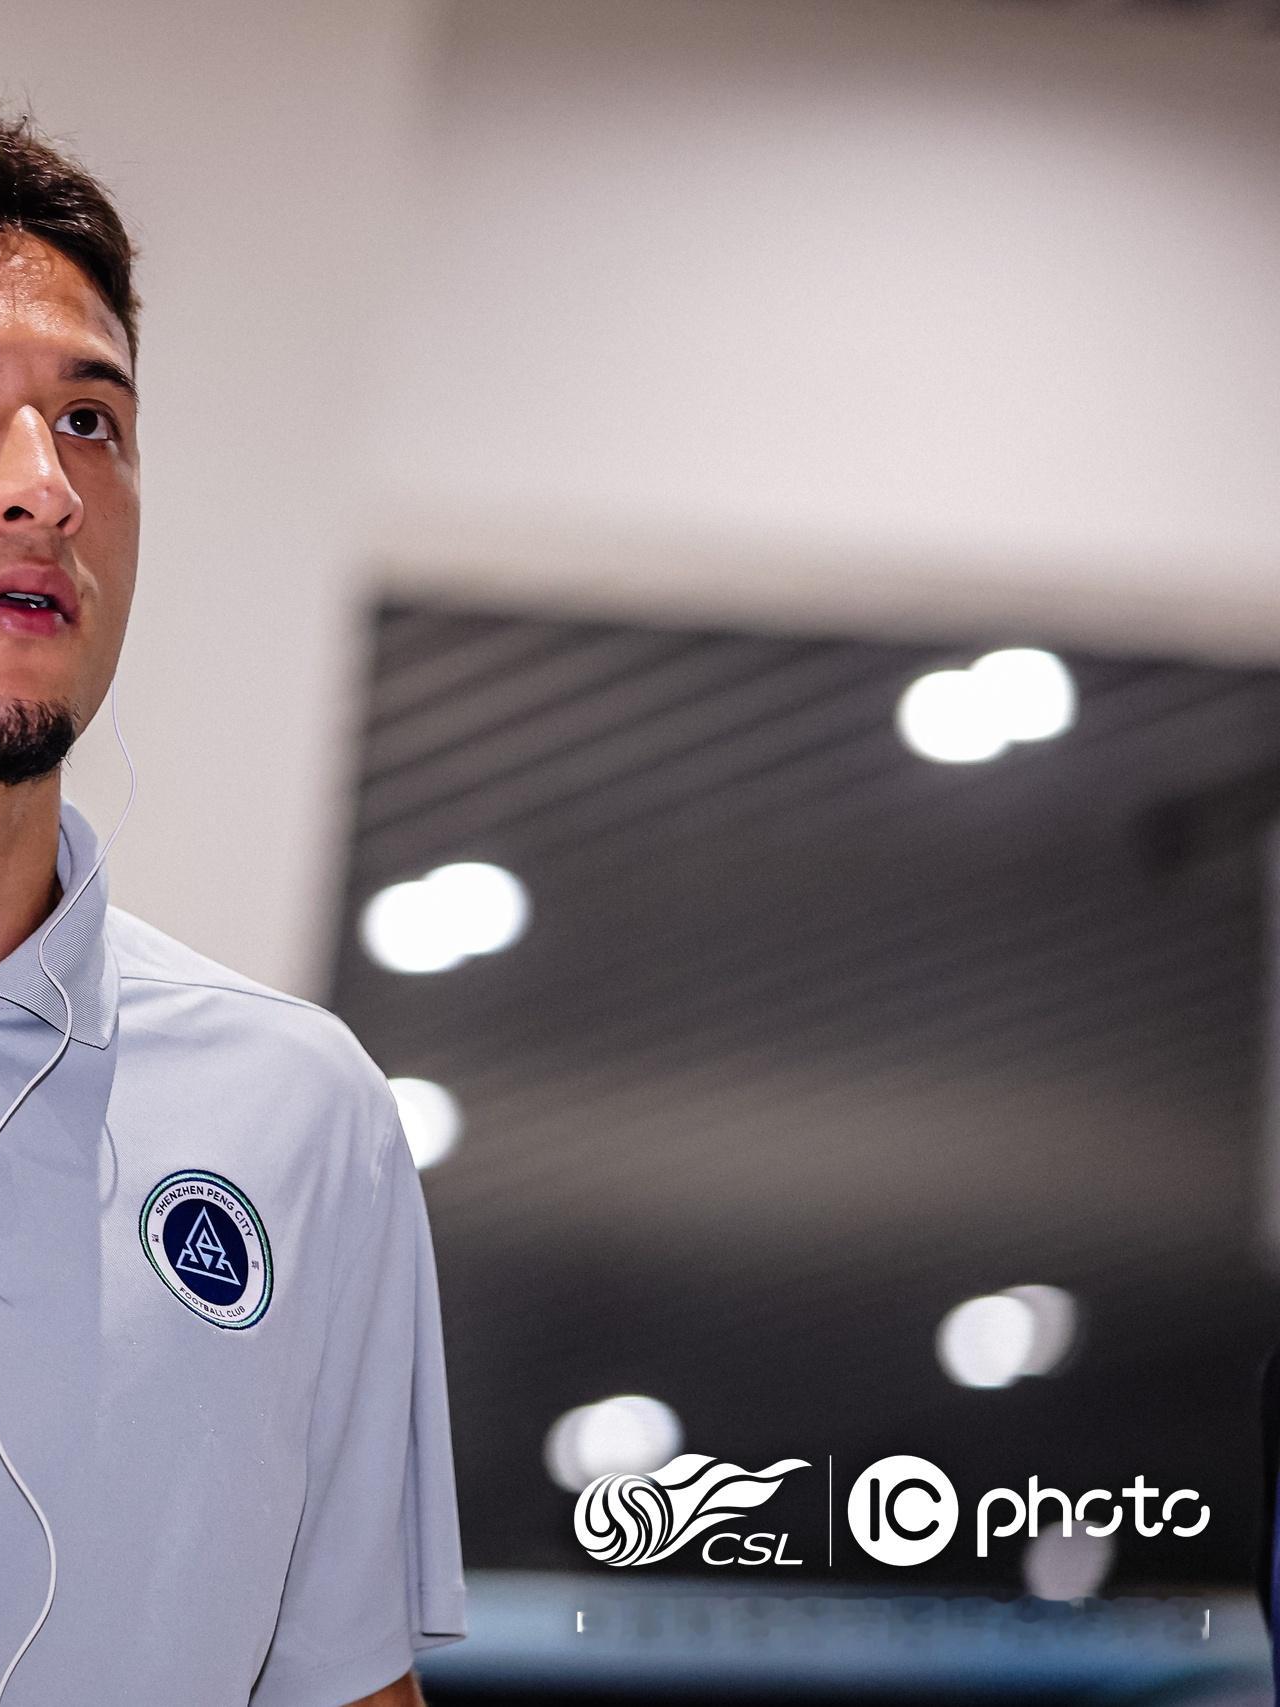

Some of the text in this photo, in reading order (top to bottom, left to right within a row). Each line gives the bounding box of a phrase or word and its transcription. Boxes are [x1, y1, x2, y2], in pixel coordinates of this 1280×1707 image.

[155, 1185, 254, 1238] SHENZHEN PENG CITY
[179, 1286, 246, 1318] FOOTBALL CLUB
